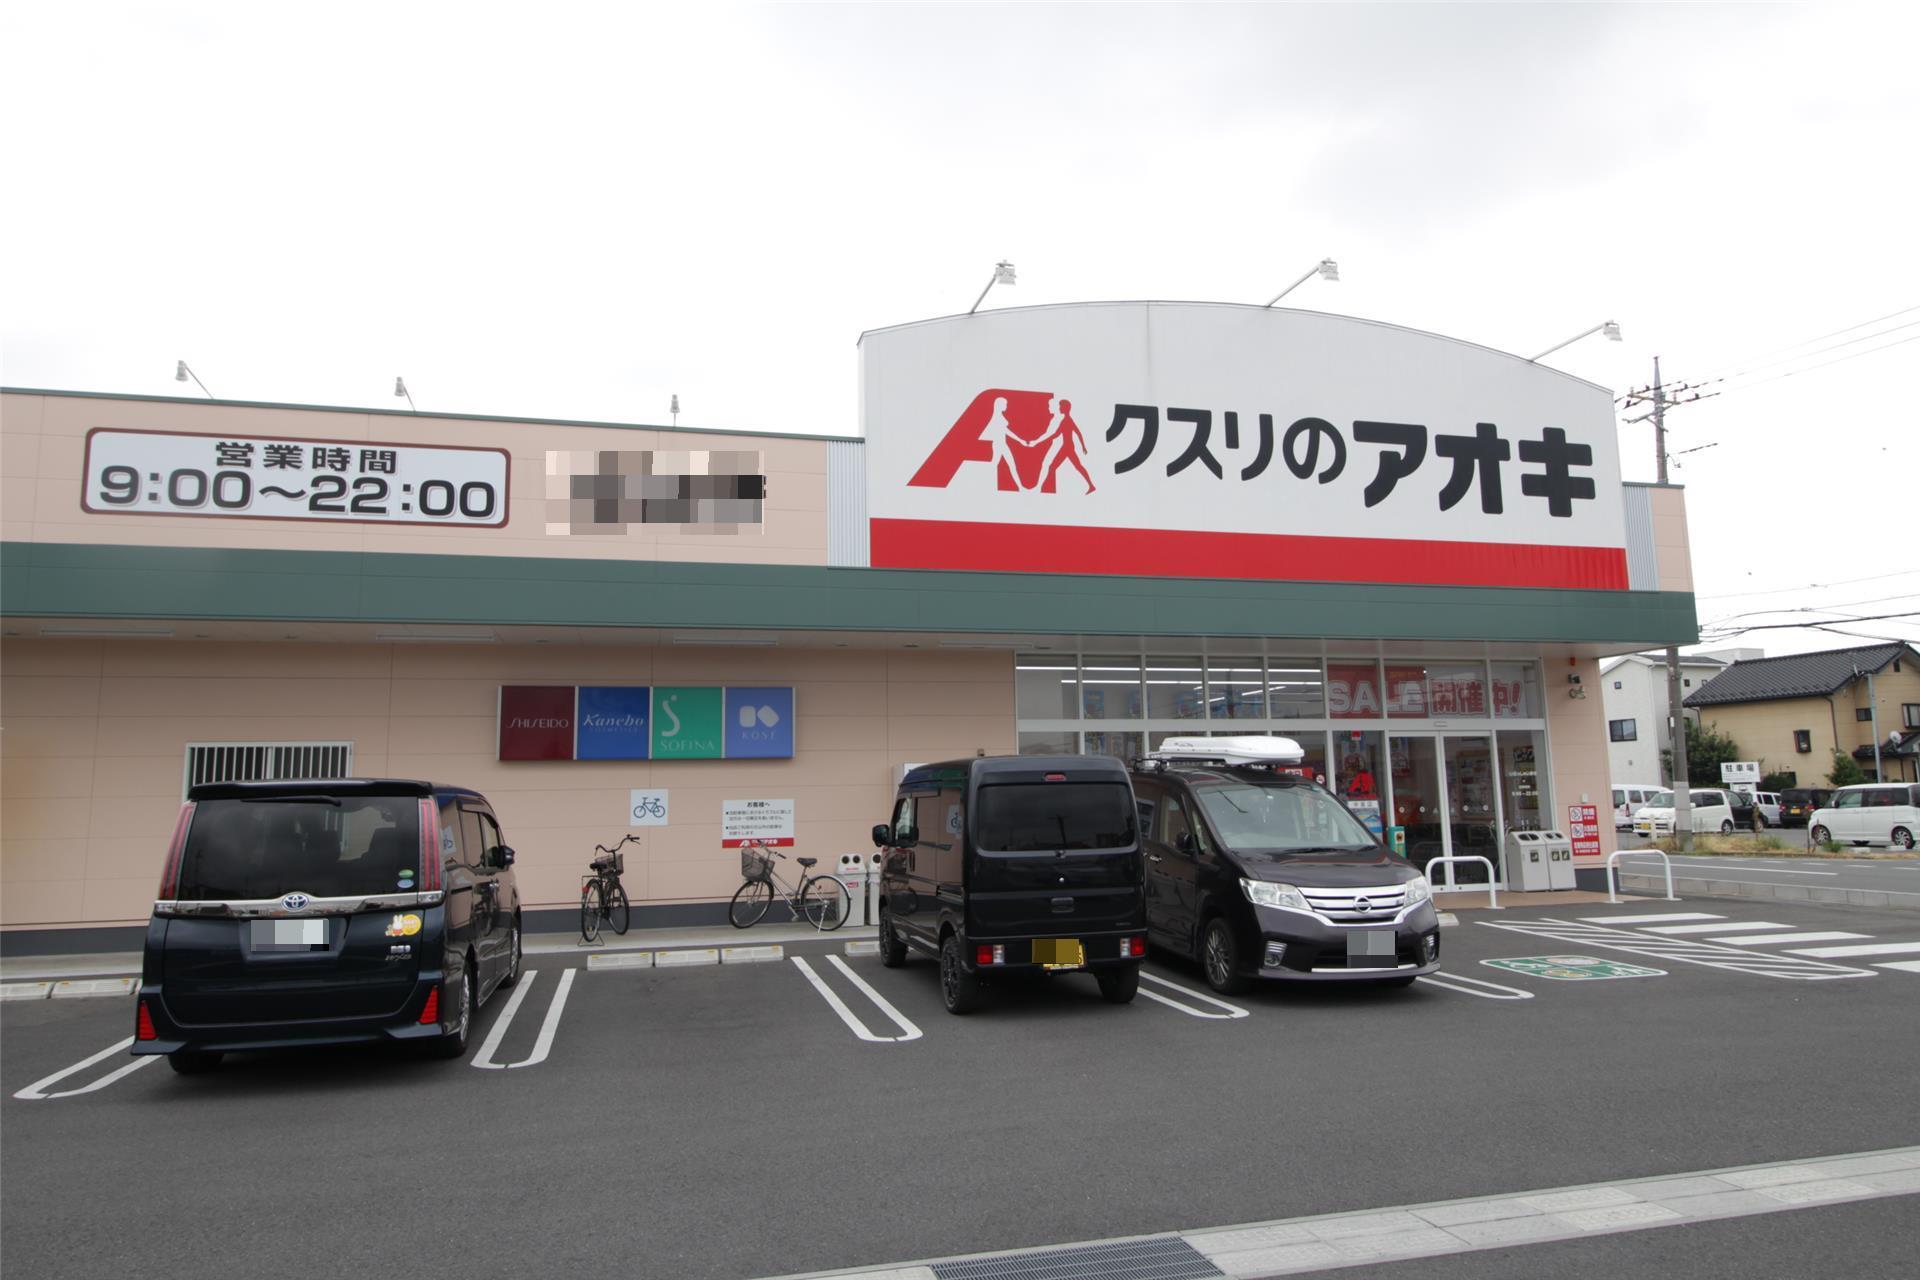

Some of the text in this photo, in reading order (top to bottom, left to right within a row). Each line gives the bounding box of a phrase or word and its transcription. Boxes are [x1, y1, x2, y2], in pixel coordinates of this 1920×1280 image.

[216, 442, 397, 474] 営業時間
[1106, 403, 1596, 518] クスリのアオキ
[1329, 680, 1425, 713] SALE
[507, 717, 569, 729] SHISEIDO
[584, 714, 644, 726] Kanebo
[660, 739, 715, 751] SOFINA
[1725, 763, 1755, 772] 駐車場
